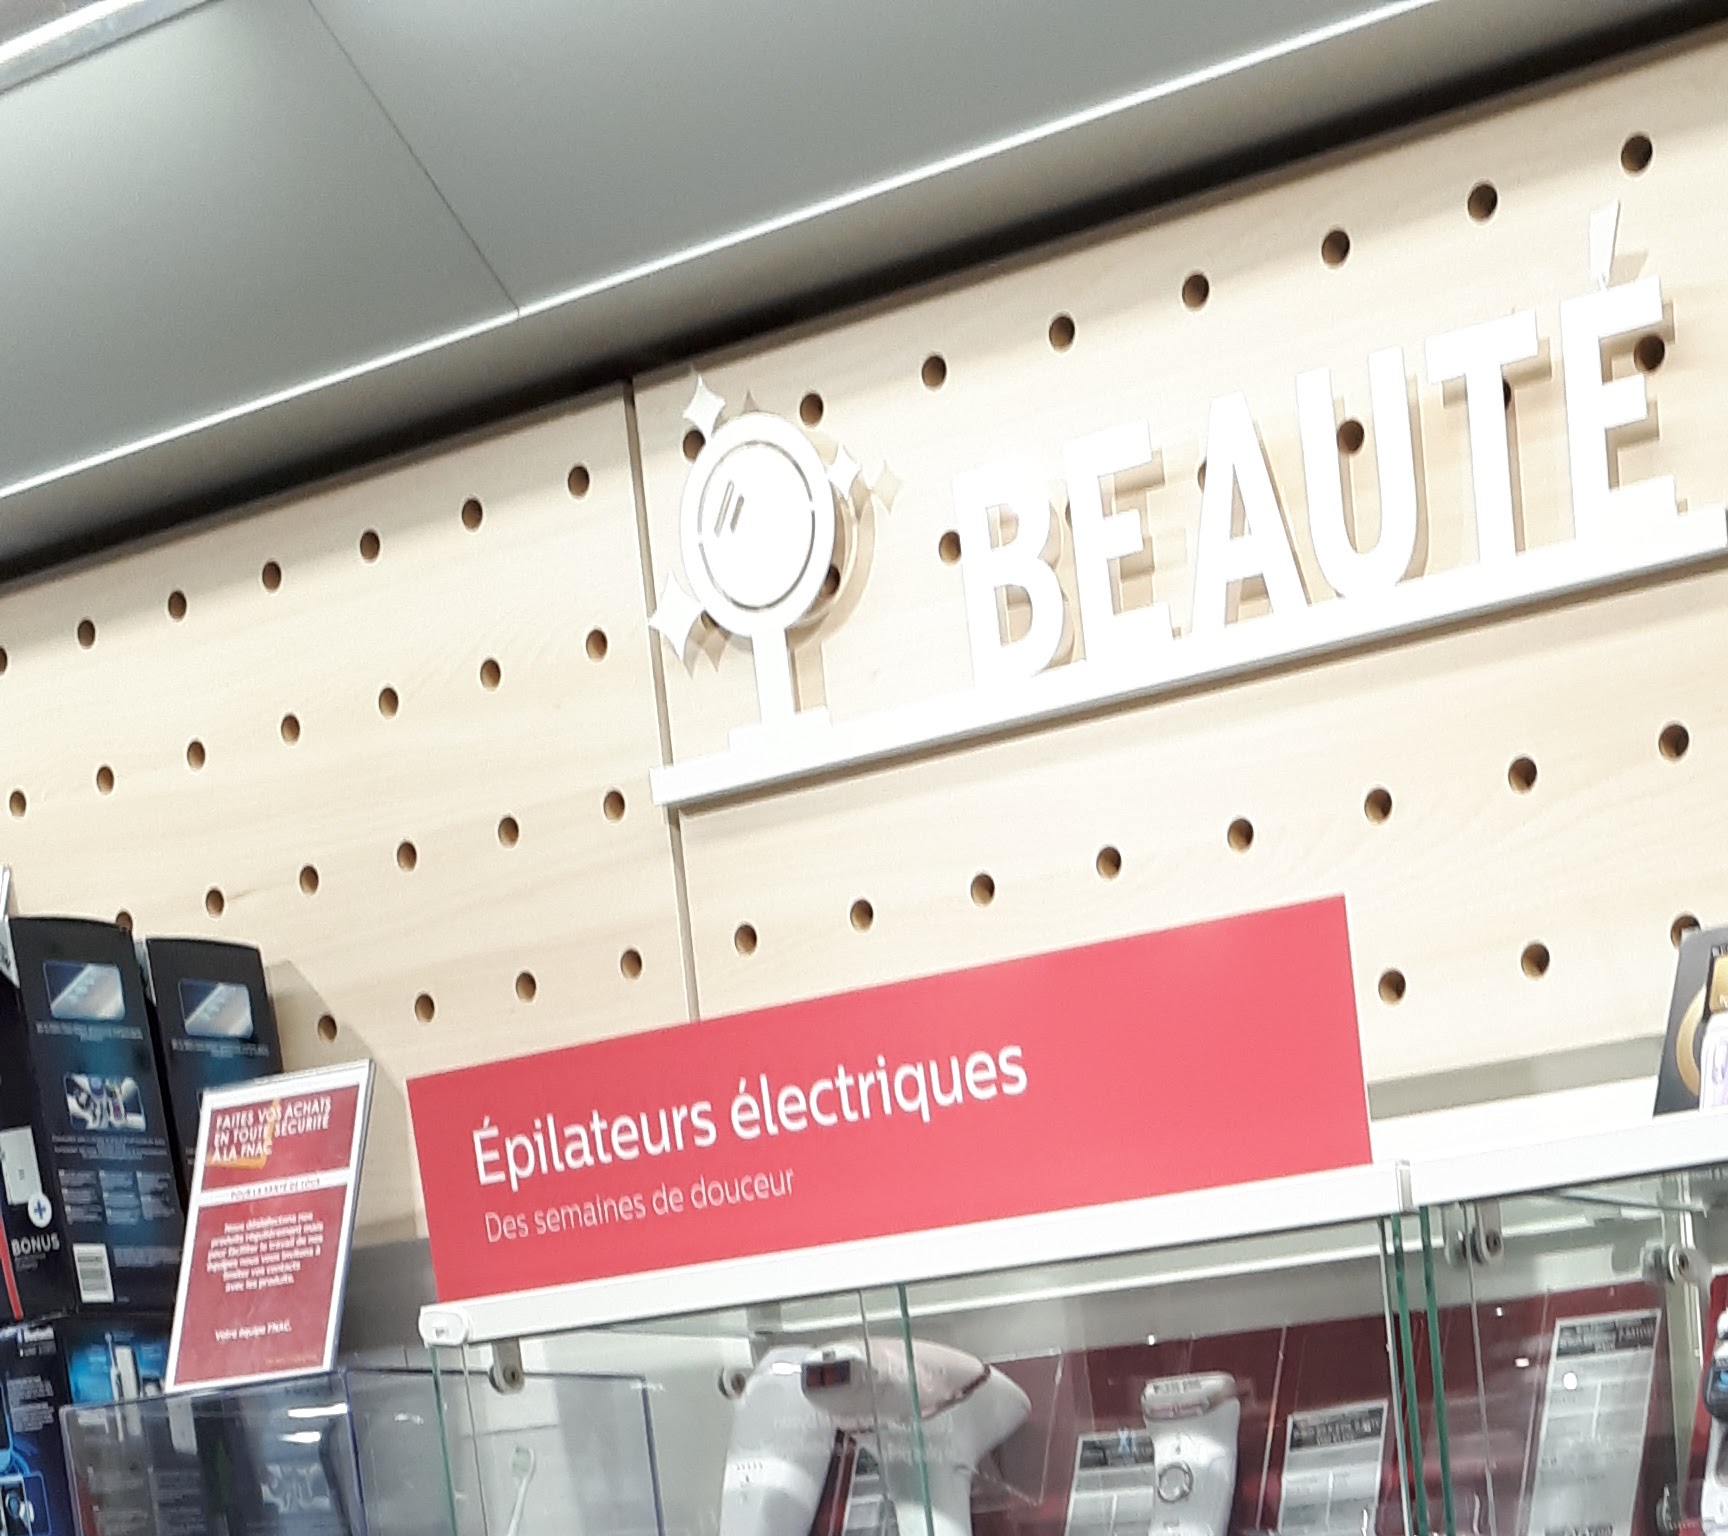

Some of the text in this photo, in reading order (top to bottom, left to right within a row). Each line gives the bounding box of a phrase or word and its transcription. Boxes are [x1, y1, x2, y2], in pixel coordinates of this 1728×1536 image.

[948, 209, 1680, 686] BEAUTÉ
[284, 1096, 332, 1118] ACHATS
[468, 1038, 1030, 1190] Épilateurs électriques
[239, 1142, 273, 1159] FNAC
[482, 1161, 796, 1245] Des semaines de douceur
[12, 1234, 61, 1258] BONUS
